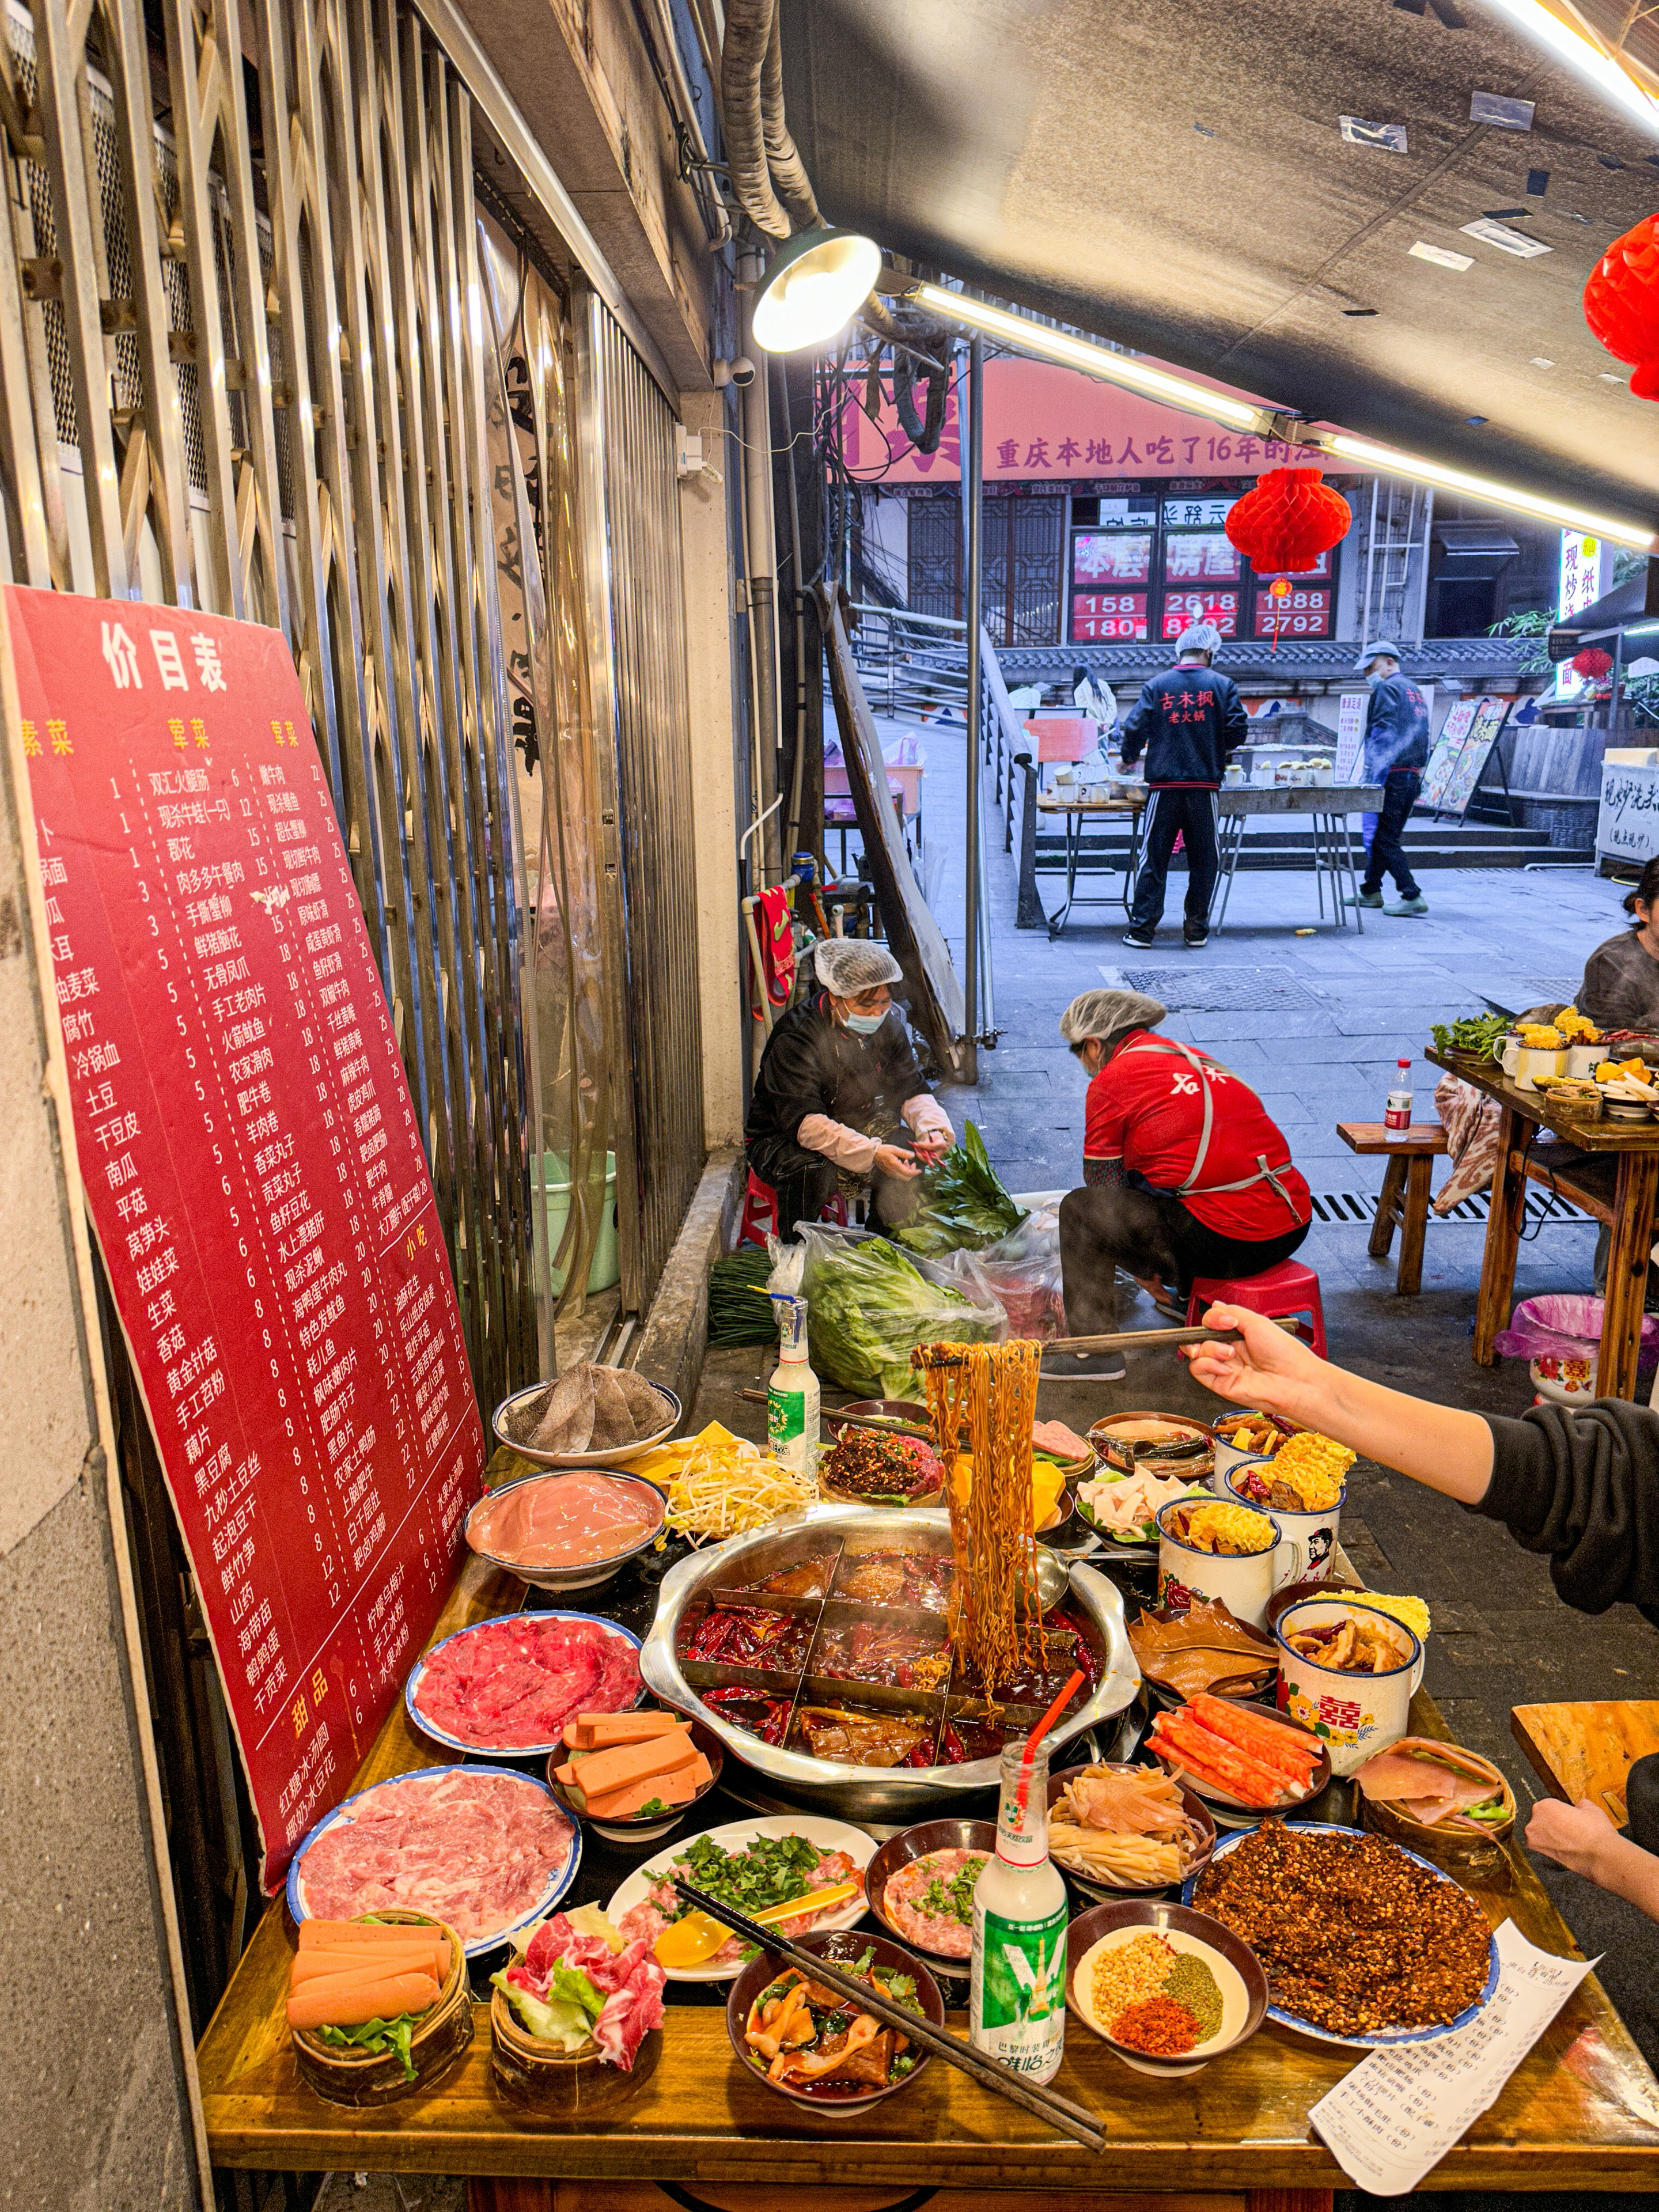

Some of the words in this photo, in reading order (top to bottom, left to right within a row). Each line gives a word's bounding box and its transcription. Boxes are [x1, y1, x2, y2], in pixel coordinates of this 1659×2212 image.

[996, 433, 1330, 469] 重庆本地人吃了16年的江
[1085, 597, 1135, 613] 158
[1262, 616, 1323, 633] 2792
[1085, 618, 1134, 636] 180
[101, 620, 227, 692] 价目表
[1159, 690, 1215, 711] 古木枫
[1168, 710, 1206, 724] 老火锅
[167, 717, 210, 749] 荤菜
[270, 719, 298, 747] 荤菜
[147, 768, 210, 796] 双汇火腿肠
[230, 768, 239, 787] 6
[119, 812, 130, 834] 1
[176, 859, 245, 895] 肉多多午餐肉
[281, 844, 321, 870] 现切鲜牛肉
[331, 842, 341, 858] 25
[184, 892, 232, 927] 手撕蟹柳
[297, 899, 329, 926] 原味虾滑
[194, 925, 242, 959] 鲜猪脑花
[271, 914, 284, 934] 15
[157, 948, 168, 969] 5
[202, 956, 250, 992] 无骨凤爪
[312, 951, 343, 980] 鱼籽虾滑
[358, 941, 368, 958] 25
[211, 982, 266, 1022] 手工老肉片
[318, 978, 350, 1007] 双椒牛肉
[61, 1008, 95, 1042] 腐竹
[222, 1017, 266, 1054] 火箭鱿鱼
[333, 1028, 363, 1060] 鲜猪黄喉
[72, 1040, 120, 1080] 冷锅血
[228, 1046, 274, 1084] 农家滑肉
[301, 1027, 313, 1047] 18
[340, 1054, 370, 1087] 麻辣牛肉
[384, 1037, 393, 1055] 25
[85, 1080, 118, 1117] 土豆
[94, 1110, 141, 1151] 干豆皮
[194, 1080, 204, 1100] 5
[236, 1080, 271, 1116] 肥牛卷
[347, 1078, 376, 1113] 虎皮鸡爪
[245, 1109, 278, 1144] 羊肉卷
[408, 1131, 416, 1149] 28
[104, 1151, 138, 1190] 南瓜
[253, 1132, 294, 1176] 香菜丸子
[261, 1161, 302, 1206] 贡菜丸子
[329, 1135, 340, 1156] 18
[115, 1187, 147, 1222] 平菇
[270, 1189, 310, 1235] 鱼籽豆花
[125, 1214, 169, 1261] 莴笋头
[136, 1246, 179, 1296] 娃娃菜
[229, 1206, 239, 1226] 5
[277, 1209, 324, 1263] 水上漂猪肝
[406, 1224, 427, 1261] 小吃
[291, 1259, 348, 1315] 海鸭蛋牛肉丸
[354, 1241, 365, 1262] 20
[147, 1289, 177, 1330] 生菜
[298, 1294, 346, 1350] 特色发鱿鱼
[399, 1282, 435, 1338] 乐山纸皮烧麦
[439, 1271, 445, 1285] 8
[156, 1323, 185, 1363] 香菇
[262, 1328, 271, 1348] 8
[306, 1338, 336, 1378] 耗儿鱼
[404, 1319, 430, 1361] 现炸平菇
[166, 1335, 217, 1399] 黄金针菇
[313, 1346, 357, 1407] 枫味嫩肉片
[415, 1358, 445, 1412] 爆浆小豆腐
[320, 1381, 355, 1437] 肥肠节子
[378, 1343, 388, 1365] 20
[420, 1380, 449, 1434] 枫味蛋炒饭
[457, 1355, 464, 1374] 15
[184, 1423, 211, 1464] 藕片
[327, 1419, 354, 1464] 黑鱼片
[334, 1424, 376, 1490] 农家土鸭肠
[194, 1442, 232, 1499] 黑豆腐
[342, 1462, 373, 1518] 上脑肥牛
[437, 1454, 464, 1512] 水果冰汤圆
[212, 1493, 256, 1563] 起泡豆干
[292, 1446, 301, 1465] 8
[347, 1487, 381, 1546] 白千层肚
[400, 1442, 410, 1465] 22
[221, 1536, 255, 1594] 鲜竹笋
[230, 1580, 254, 1625] 山药
[367, 1561, 405, 1633] 柠檬乌梅汁
[237, 1597, 272, 1658] 海带苗
[245, 1626, 280, 1687] 鹌鹑蛋
[321, 1554, 334, 1580] 12
[373, 1594, 405, 1655] 手工冰粉
[379, 1622, 409, 1684] 水果冰粉
[428, 1571, 437, 1593] 12
[253, 1656, 287, 1714] 干贡菜
[291, 1667, 328, 1738] 甜品
[279, 1721, 330, 1817] 红糖冰汤圆
[286, 1749, 336, 1847] 椰奶冰豆花
